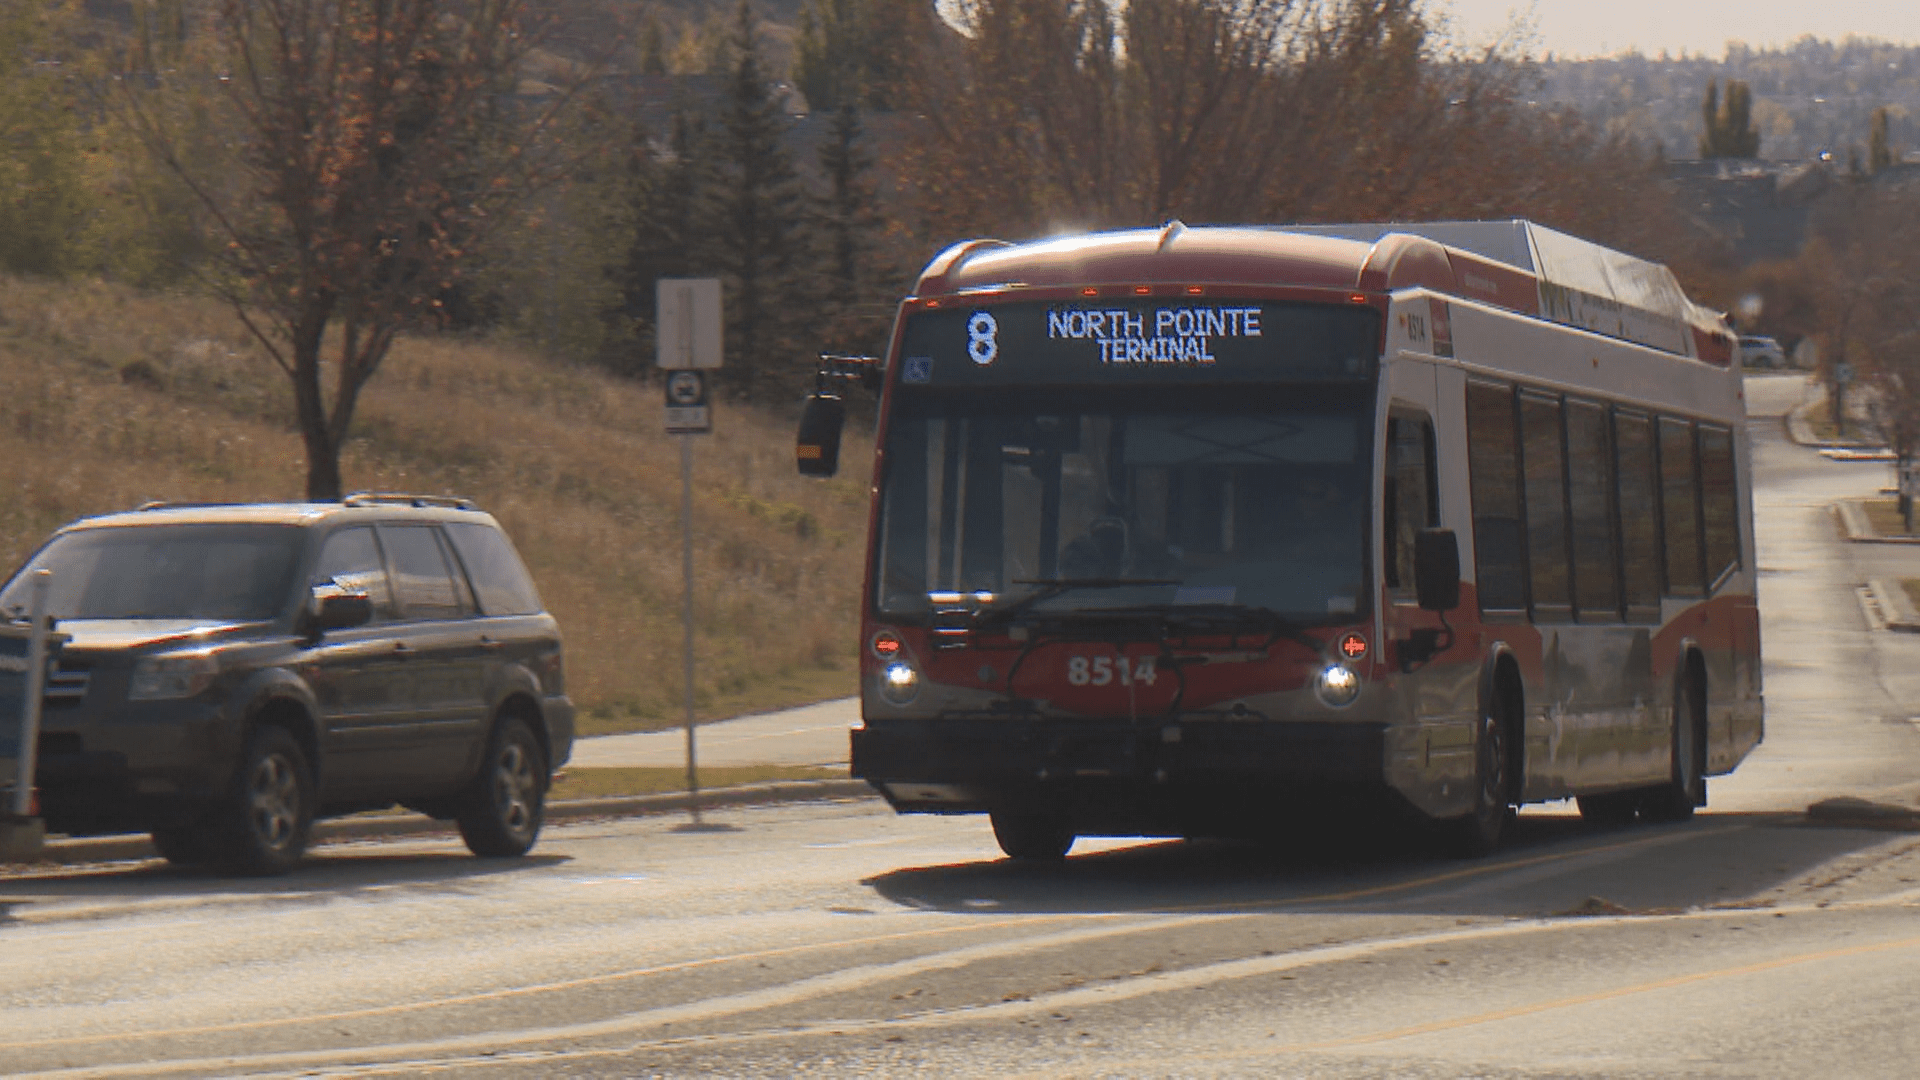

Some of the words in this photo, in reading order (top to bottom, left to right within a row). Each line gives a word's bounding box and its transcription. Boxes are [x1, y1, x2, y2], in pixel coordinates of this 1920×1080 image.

[967, 311, 999, 365] 8
[1048, 310, 1144, 339] NORTH
[1155, 307, 1263, 337] POINTE
[1097, 336, 1216, 363] TERMINAL
[1068, 655, 1157, 686] 8514
